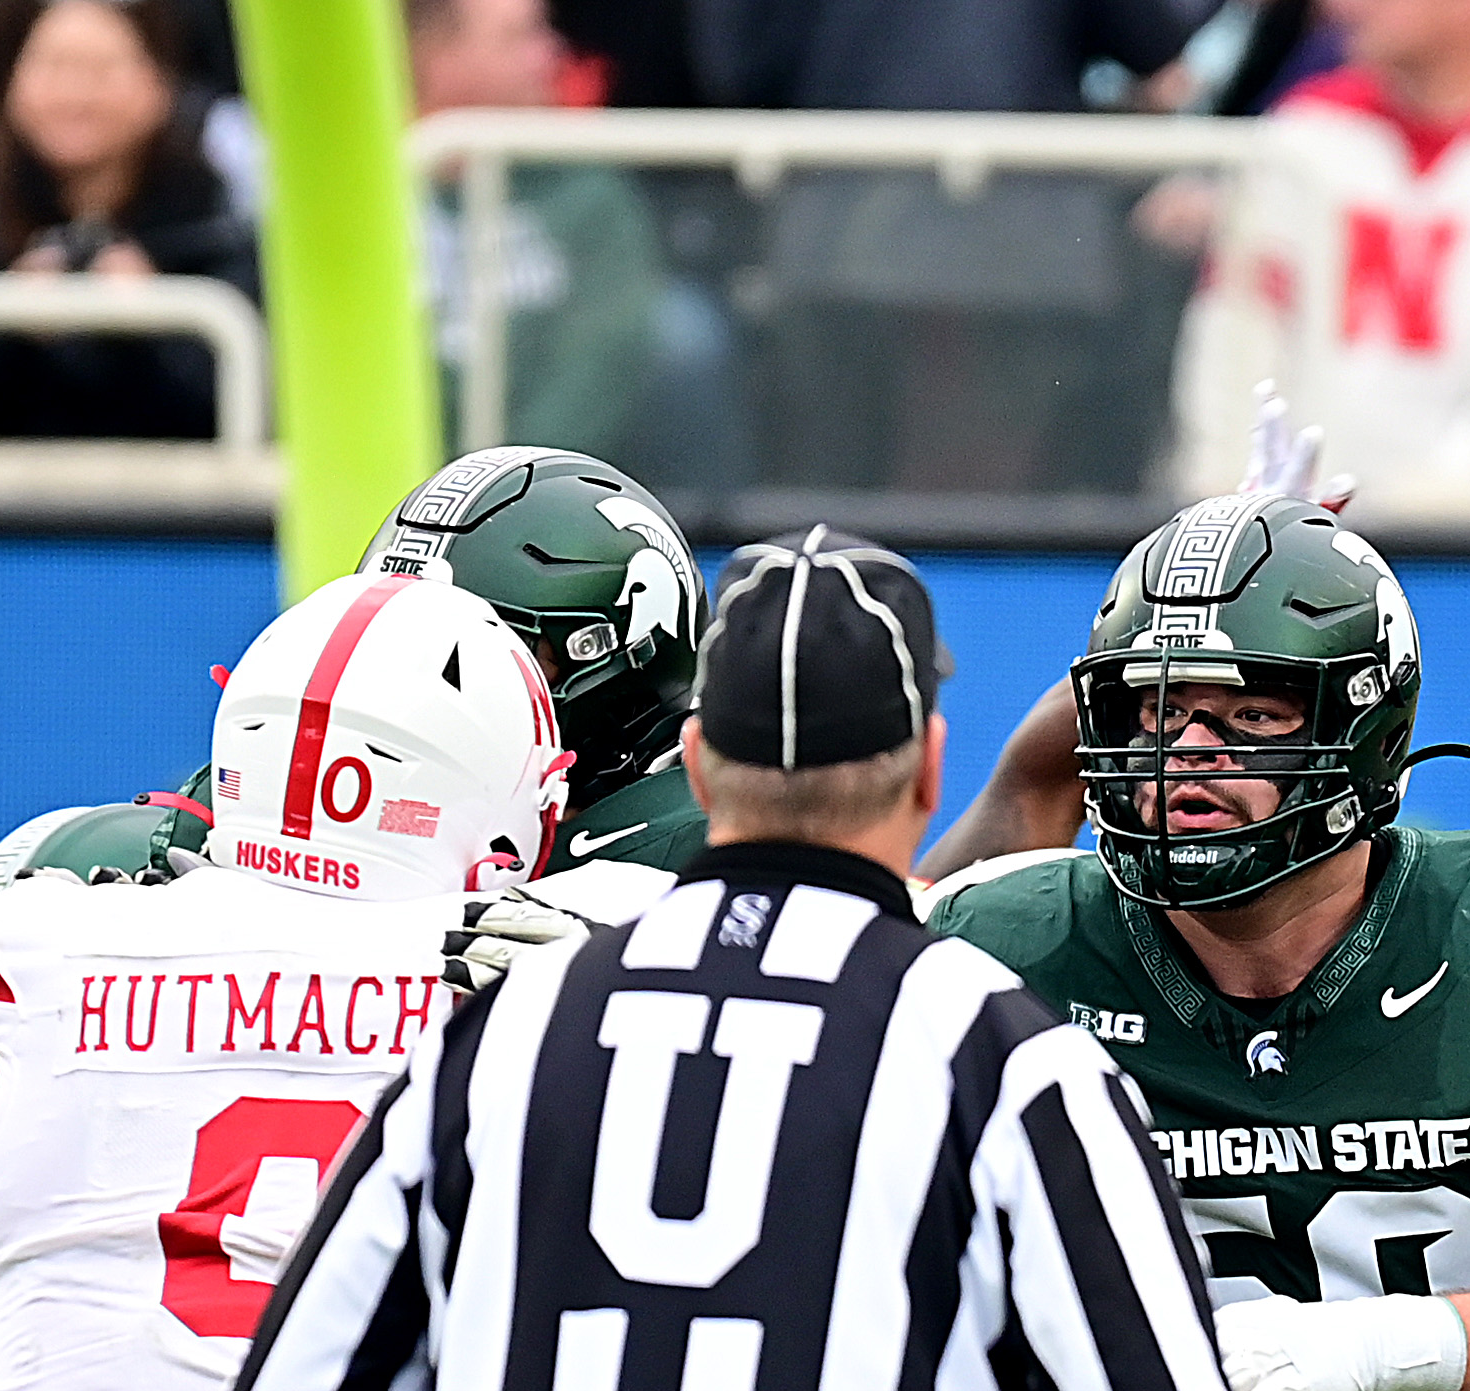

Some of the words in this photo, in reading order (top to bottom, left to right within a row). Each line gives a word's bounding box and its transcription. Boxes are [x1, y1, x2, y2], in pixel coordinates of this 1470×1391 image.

[1342, 207, 1461, 352] N
[380, 555, 428, 576] STATE
[1153, 634, 1206, 649] STATE
[321, 756, 372, 823] 0
[236, 840, 360, 890] HUSKERS
[75, 972, 439, 1055] HUTMACH
[588, 990, 825, 1289] U
